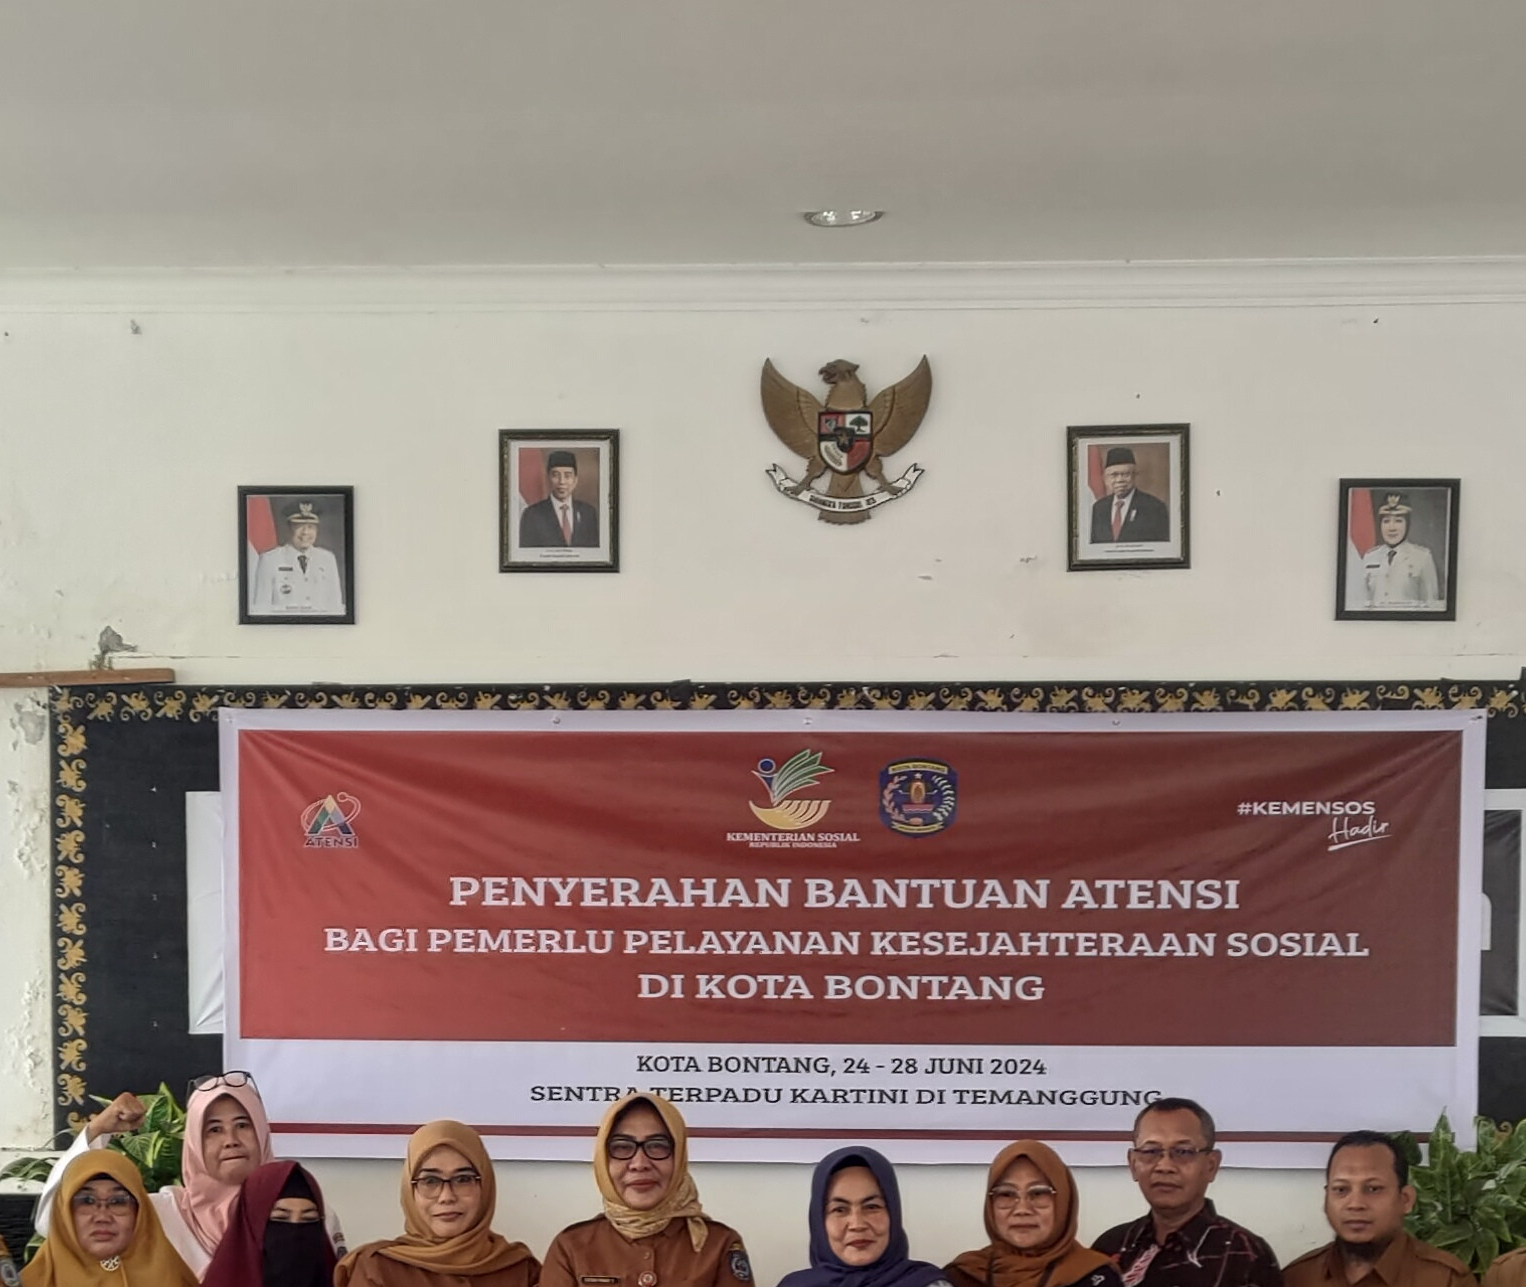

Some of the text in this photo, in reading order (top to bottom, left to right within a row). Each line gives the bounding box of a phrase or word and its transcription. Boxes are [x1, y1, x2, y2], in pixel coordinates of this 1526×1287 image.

[1237, 801, 1375, 815] #KEMENSOS
[726, 832, 861, 841] KEMENTERIAN SOSIAL
[1328, 815, 1389, 843] Hadir
[303, 836, 359, 848] ATENSI
[449, 876, 1241, 910] PENYERAHAN BANTUAN ATENSI
[323, 928, 1370, 957] BAGI PEMERLU PELAYANAN KESEJAHTERAAN SOSIAL
[637, 973, 1046, 1001] DI KOTA BONTANG
[636, 1055, 702, 1073] KOTA
[706, 1056, 837, 1077] BONTANG,
[843, 1058, 870, 1074] 24
[890, 1058, 918, 1075] 28
[924, 1058, 984, 1075] JUNI
[989, 1058, 1048, 1075] 2024
[789, 1088, 909, 1105] KARTINI
[914, 1089, 947, 1105] DI
